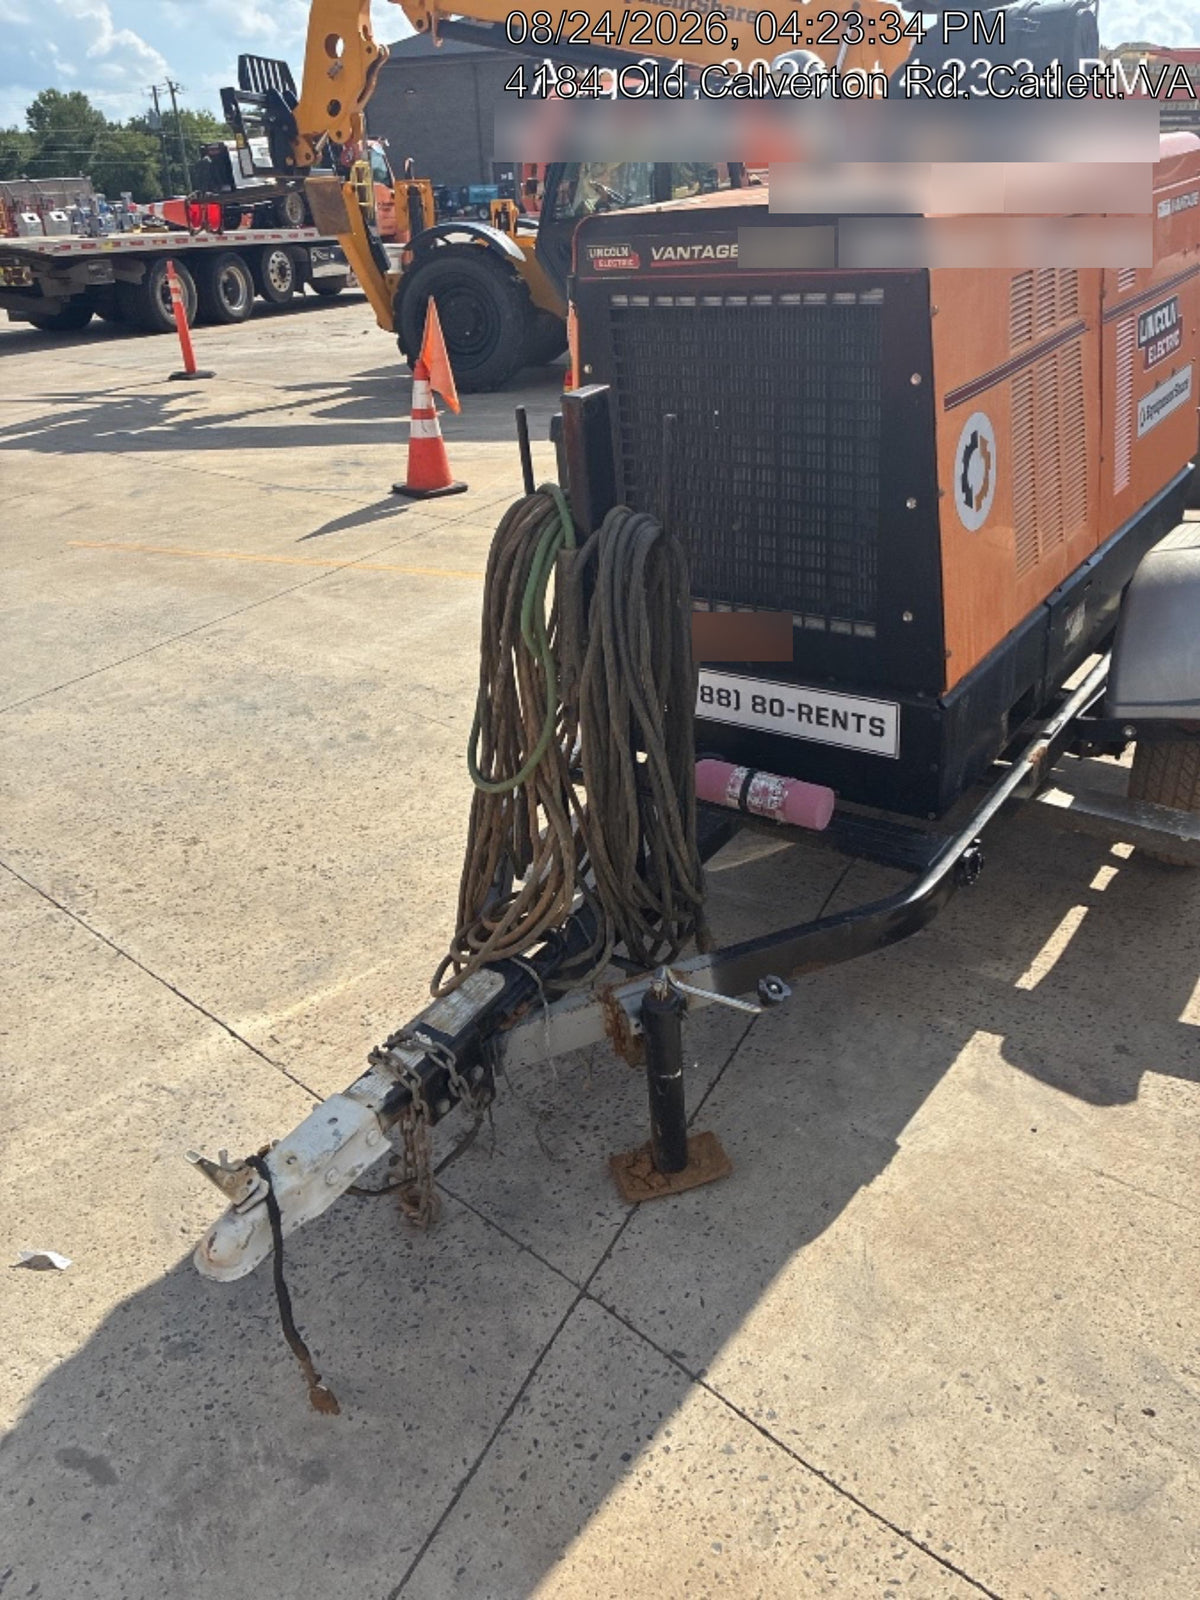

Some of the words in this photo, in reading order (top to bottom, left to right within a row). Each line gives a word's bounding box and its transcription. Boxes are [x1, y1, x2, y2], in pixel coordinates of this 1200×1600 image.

[589, 246, 629, 259] LINCOLN
[598, 259, 634, 268] ELECTRIC
[651, 244, 738, 261] VANTAGE
[1139, 301, 1178, 344] LINCOLN
[1147, 329, 1180, 365] ELECTRIC
[751, 694, 886, 738] 80-RENTS
